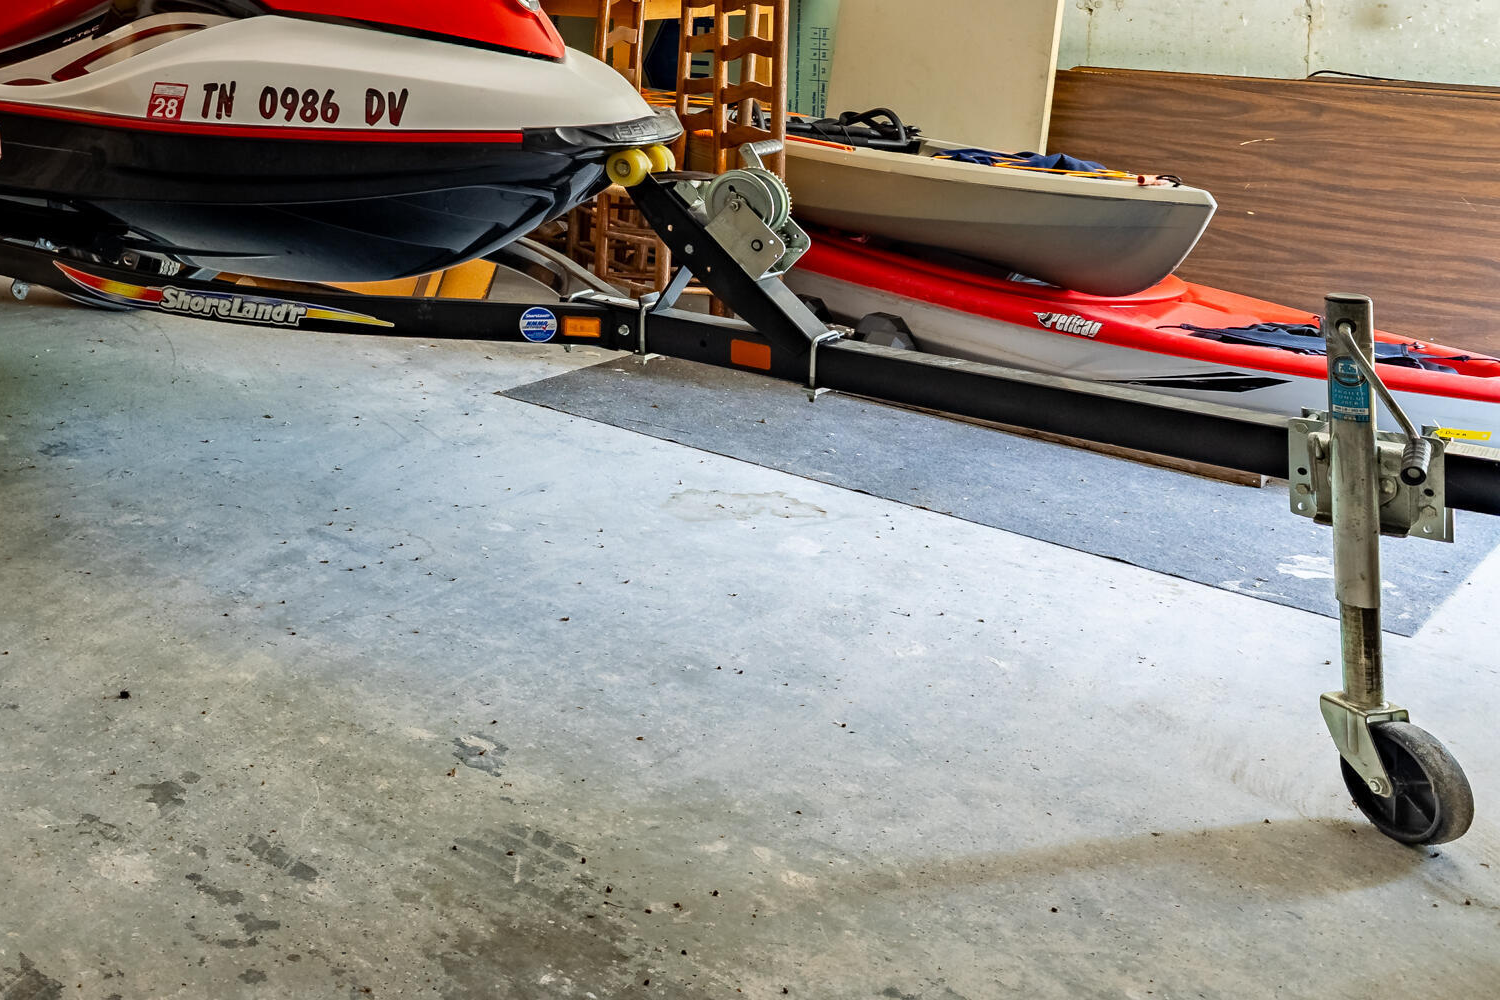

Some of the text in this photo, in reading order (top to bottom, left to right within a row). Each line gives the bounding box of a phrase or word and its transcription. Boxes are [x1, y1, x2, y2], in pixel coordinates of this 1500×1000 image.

[152, 97, 178, 119] 28
[201, 81, 409, 127] TN 0986 DV
[160, 287, 308, 325] ShoreLand'r
[1033, 312, 1103, 338] Pelican
